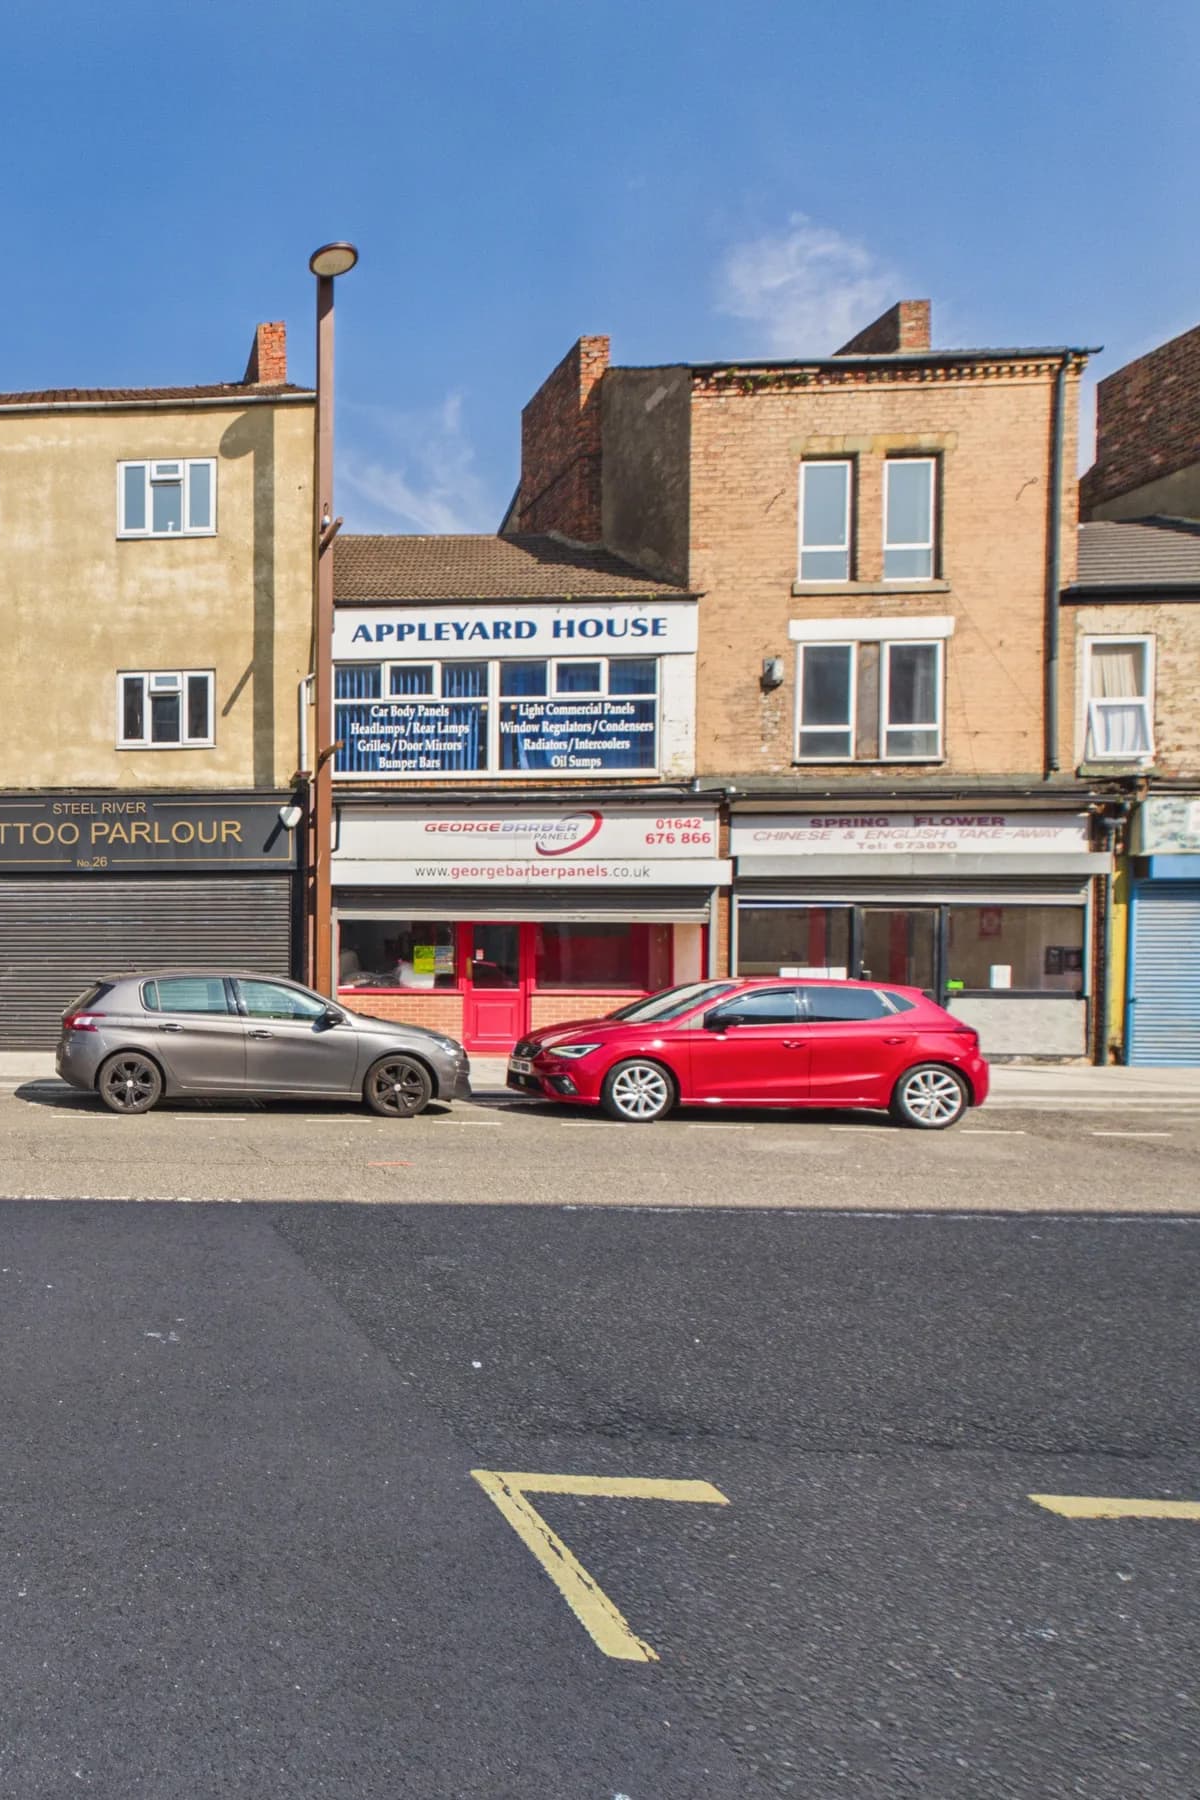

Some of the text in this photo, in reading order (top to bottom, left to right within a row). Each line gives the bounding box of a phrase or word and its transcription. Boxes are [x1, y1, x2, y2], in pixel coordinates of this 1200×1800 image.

[352, 617, 668, 643] APPLEYARD HOUSE
[371, 704, 450, 720] Car Body Panels
[519, 702, 636, 719] Light Commercial Panels
[437, 722, 470, 737] Lamps
[500, 720, 540, 734] Window
[425, 739, 463, 751] Mirrors
[379, 756, 441, 770] Bumper Bars
[551, 754, 602, 769] Oil Sumps
[52, 801, 147, 815] STEEL RIVER
[656, 818, 702, 830] 01642
[809, 815, 1006, 829] SPRING FLOWER
[90, 820, 243, 844] PARLOUR
[533, 832, 578, 841] PANELS
[645, 831, 712, 844] 676 866
[753, 830, 833, 842] CHINESE
[843, 829, 857, 840] &
[864, 828, 947, 840] ENGLISH
[958, 827, 1064, 840] TAKE-AWAY
[856, 842, 888, 851] Tel:
[415, 863, 650, 880] www.georgebarberpanels.co.uk
